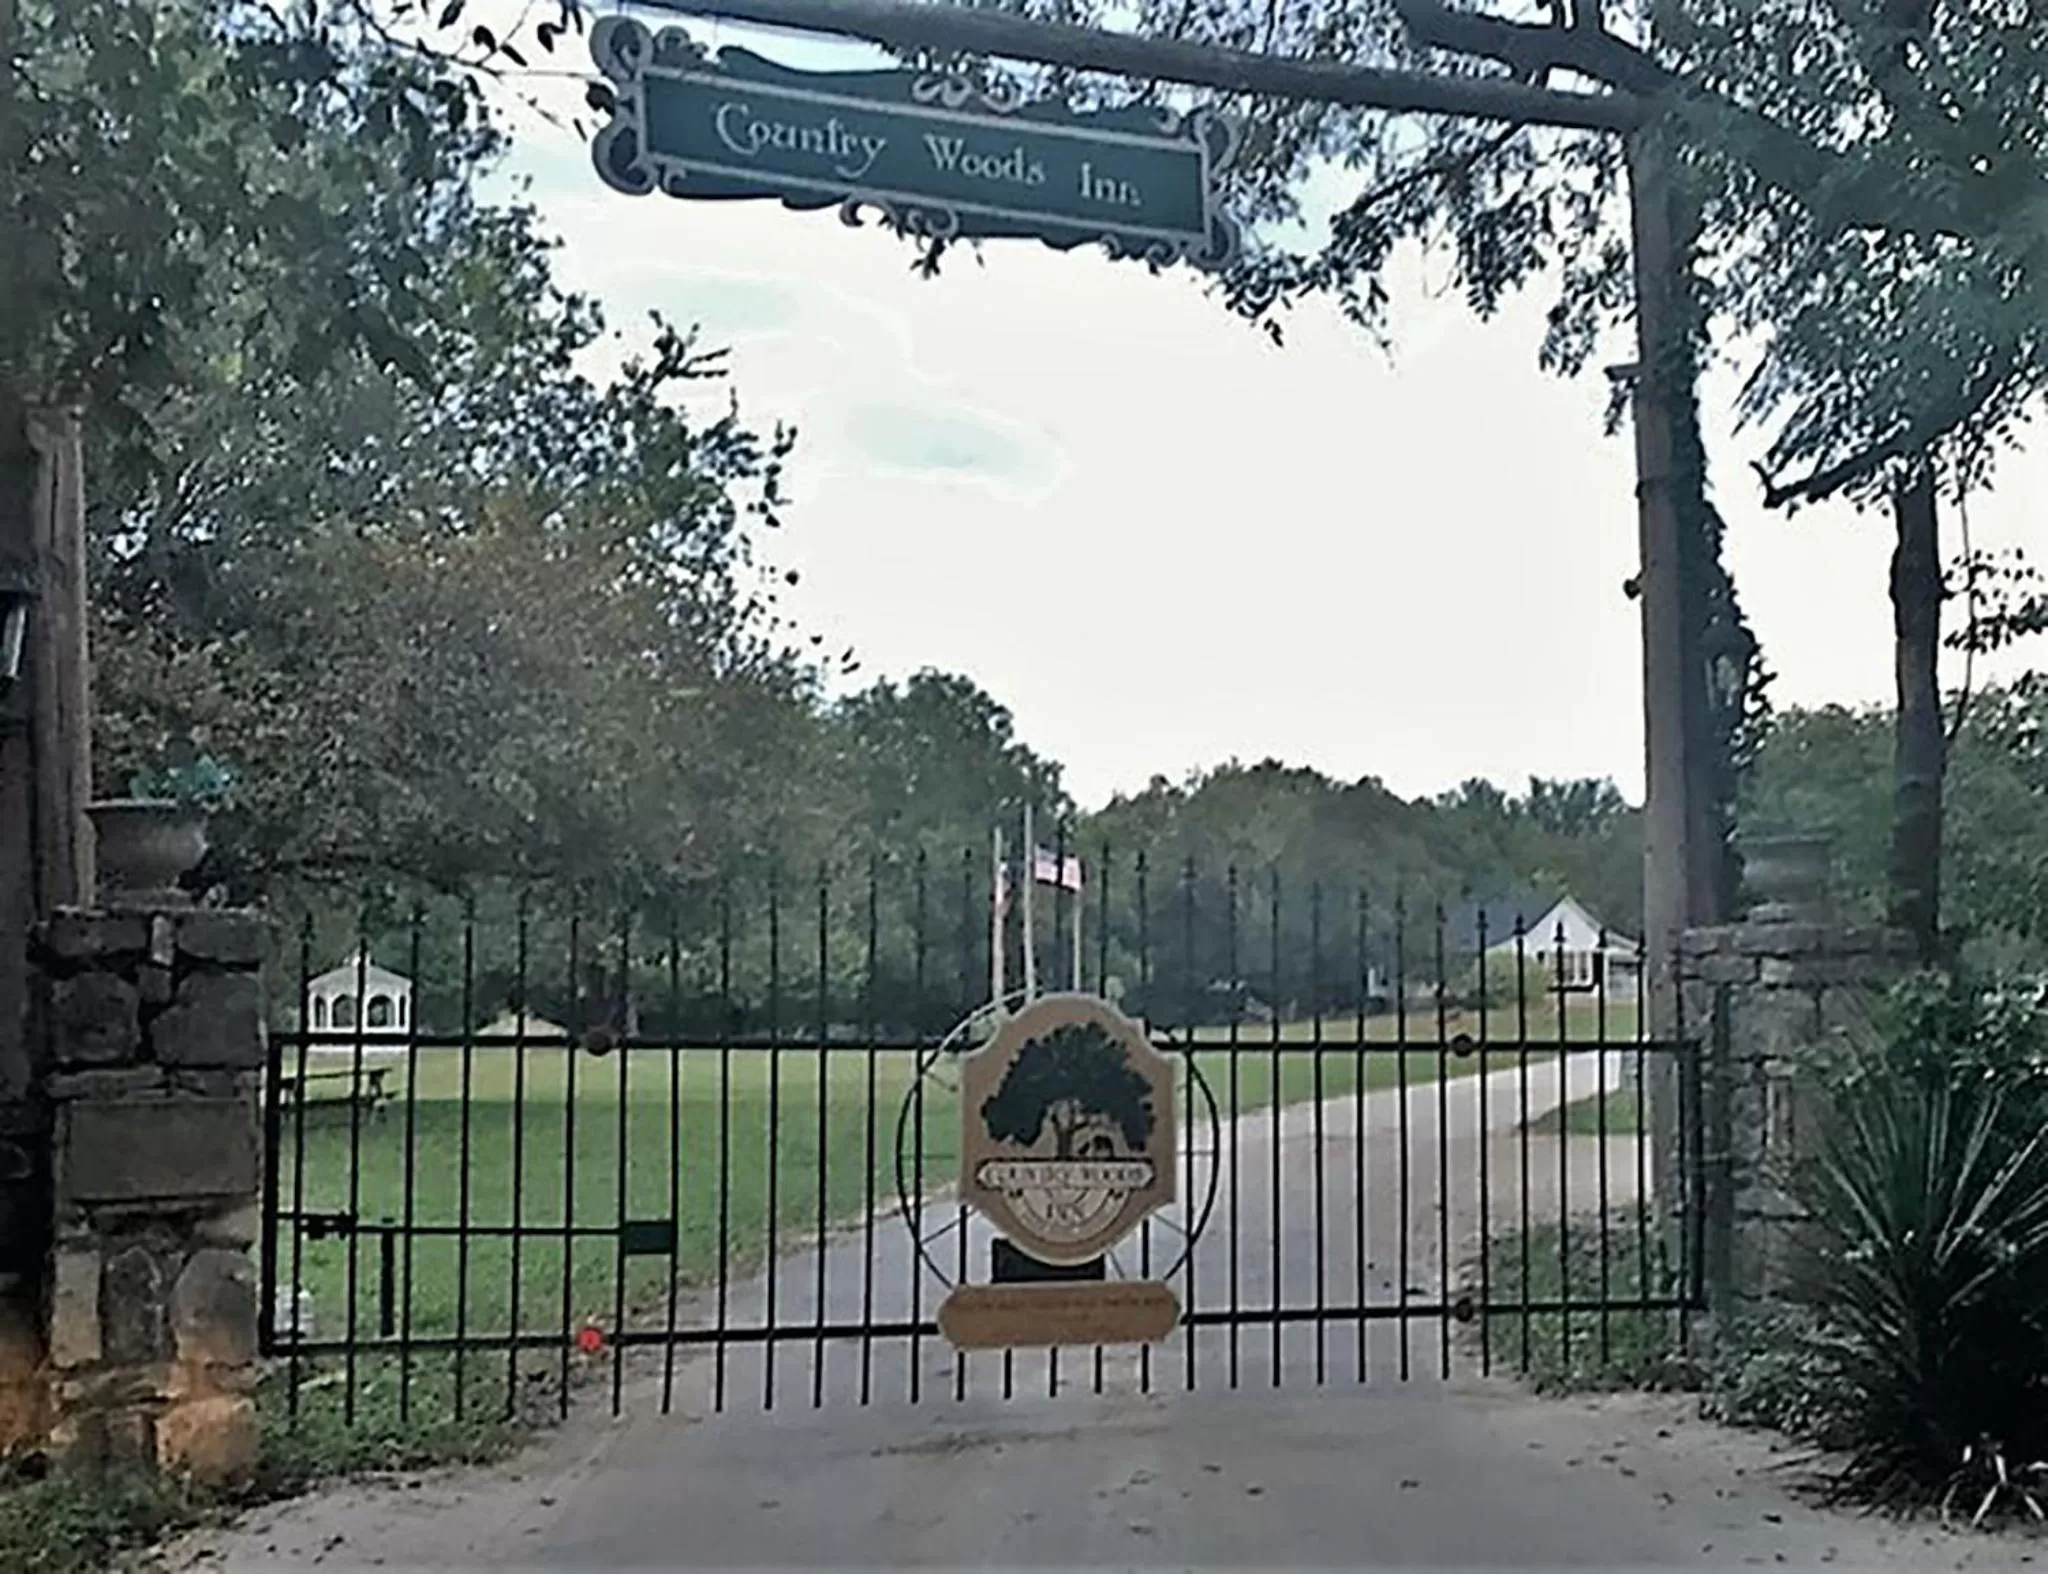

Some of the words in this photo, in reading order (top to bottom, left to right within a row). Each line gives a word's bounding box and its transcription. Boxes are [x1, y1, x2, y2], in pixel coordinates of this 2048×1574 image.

[716, 102, 887, 179] Country
[922, 133, 1047, 186] Woods
[1079, 161, 1142, 206] Inn
